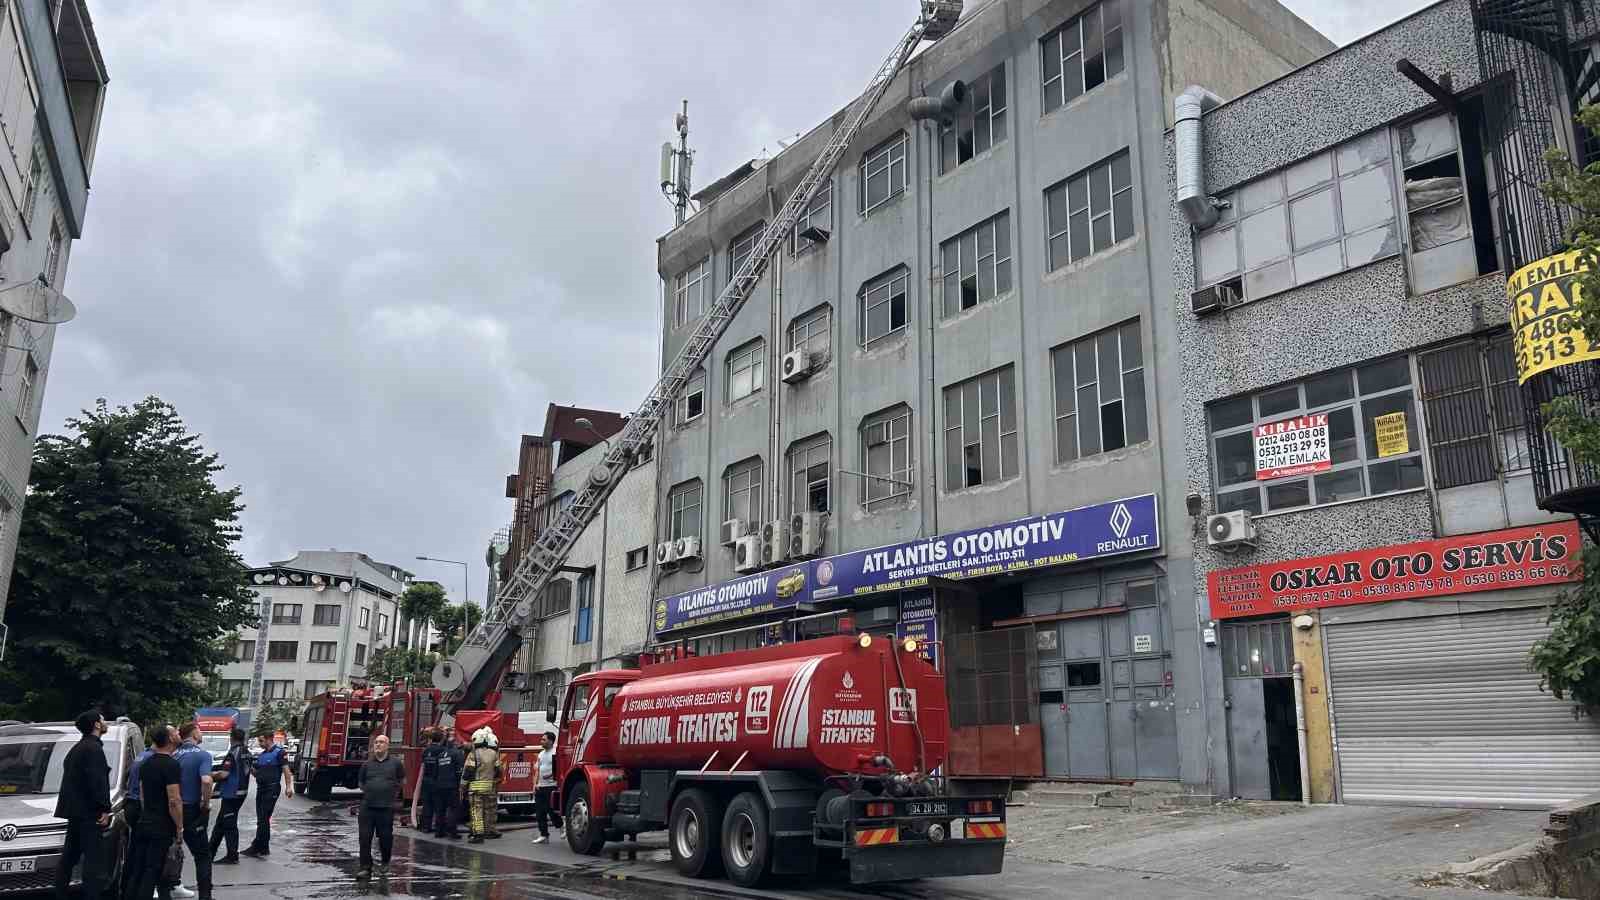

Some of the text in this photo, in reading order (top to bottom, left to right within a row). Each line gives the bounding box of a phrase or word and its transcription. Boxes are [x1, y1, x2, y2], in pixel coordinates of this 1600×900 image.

[1533, 336, 1576, 366] 513
[1259, 427, 1326, 447] 0212 480 08 08
[1259, 437, 1327, 458] 0532 513 29 95
[1289, 450, 1328, 464] EMLAK
[862, 538, 947, 574] ATLANTİS
[952, 515, 1065, 557] OTOMOTİV
[1097, 534, 1150, 553] RENAULT
[1269, 530, 1568, 593] OSKAR OTO SERVİS
[1274, 595, 1297, 607] 0532
[1323, 590, 1335, 601] 97
[1338, 588, 1353, 599] 40
[1362, 584, 1390, 596] 0538
[1393, 579, 1416, 593] 818
[1420, 579, 1433, 590] 79
[1437, 576, 1453, 589] 78
[1464, 572, 1495, 585] 0530
[1529, 566, 1545, 579] 66
[750, 690, 768, 712] 112
[20, 861, 33, 871] 52
